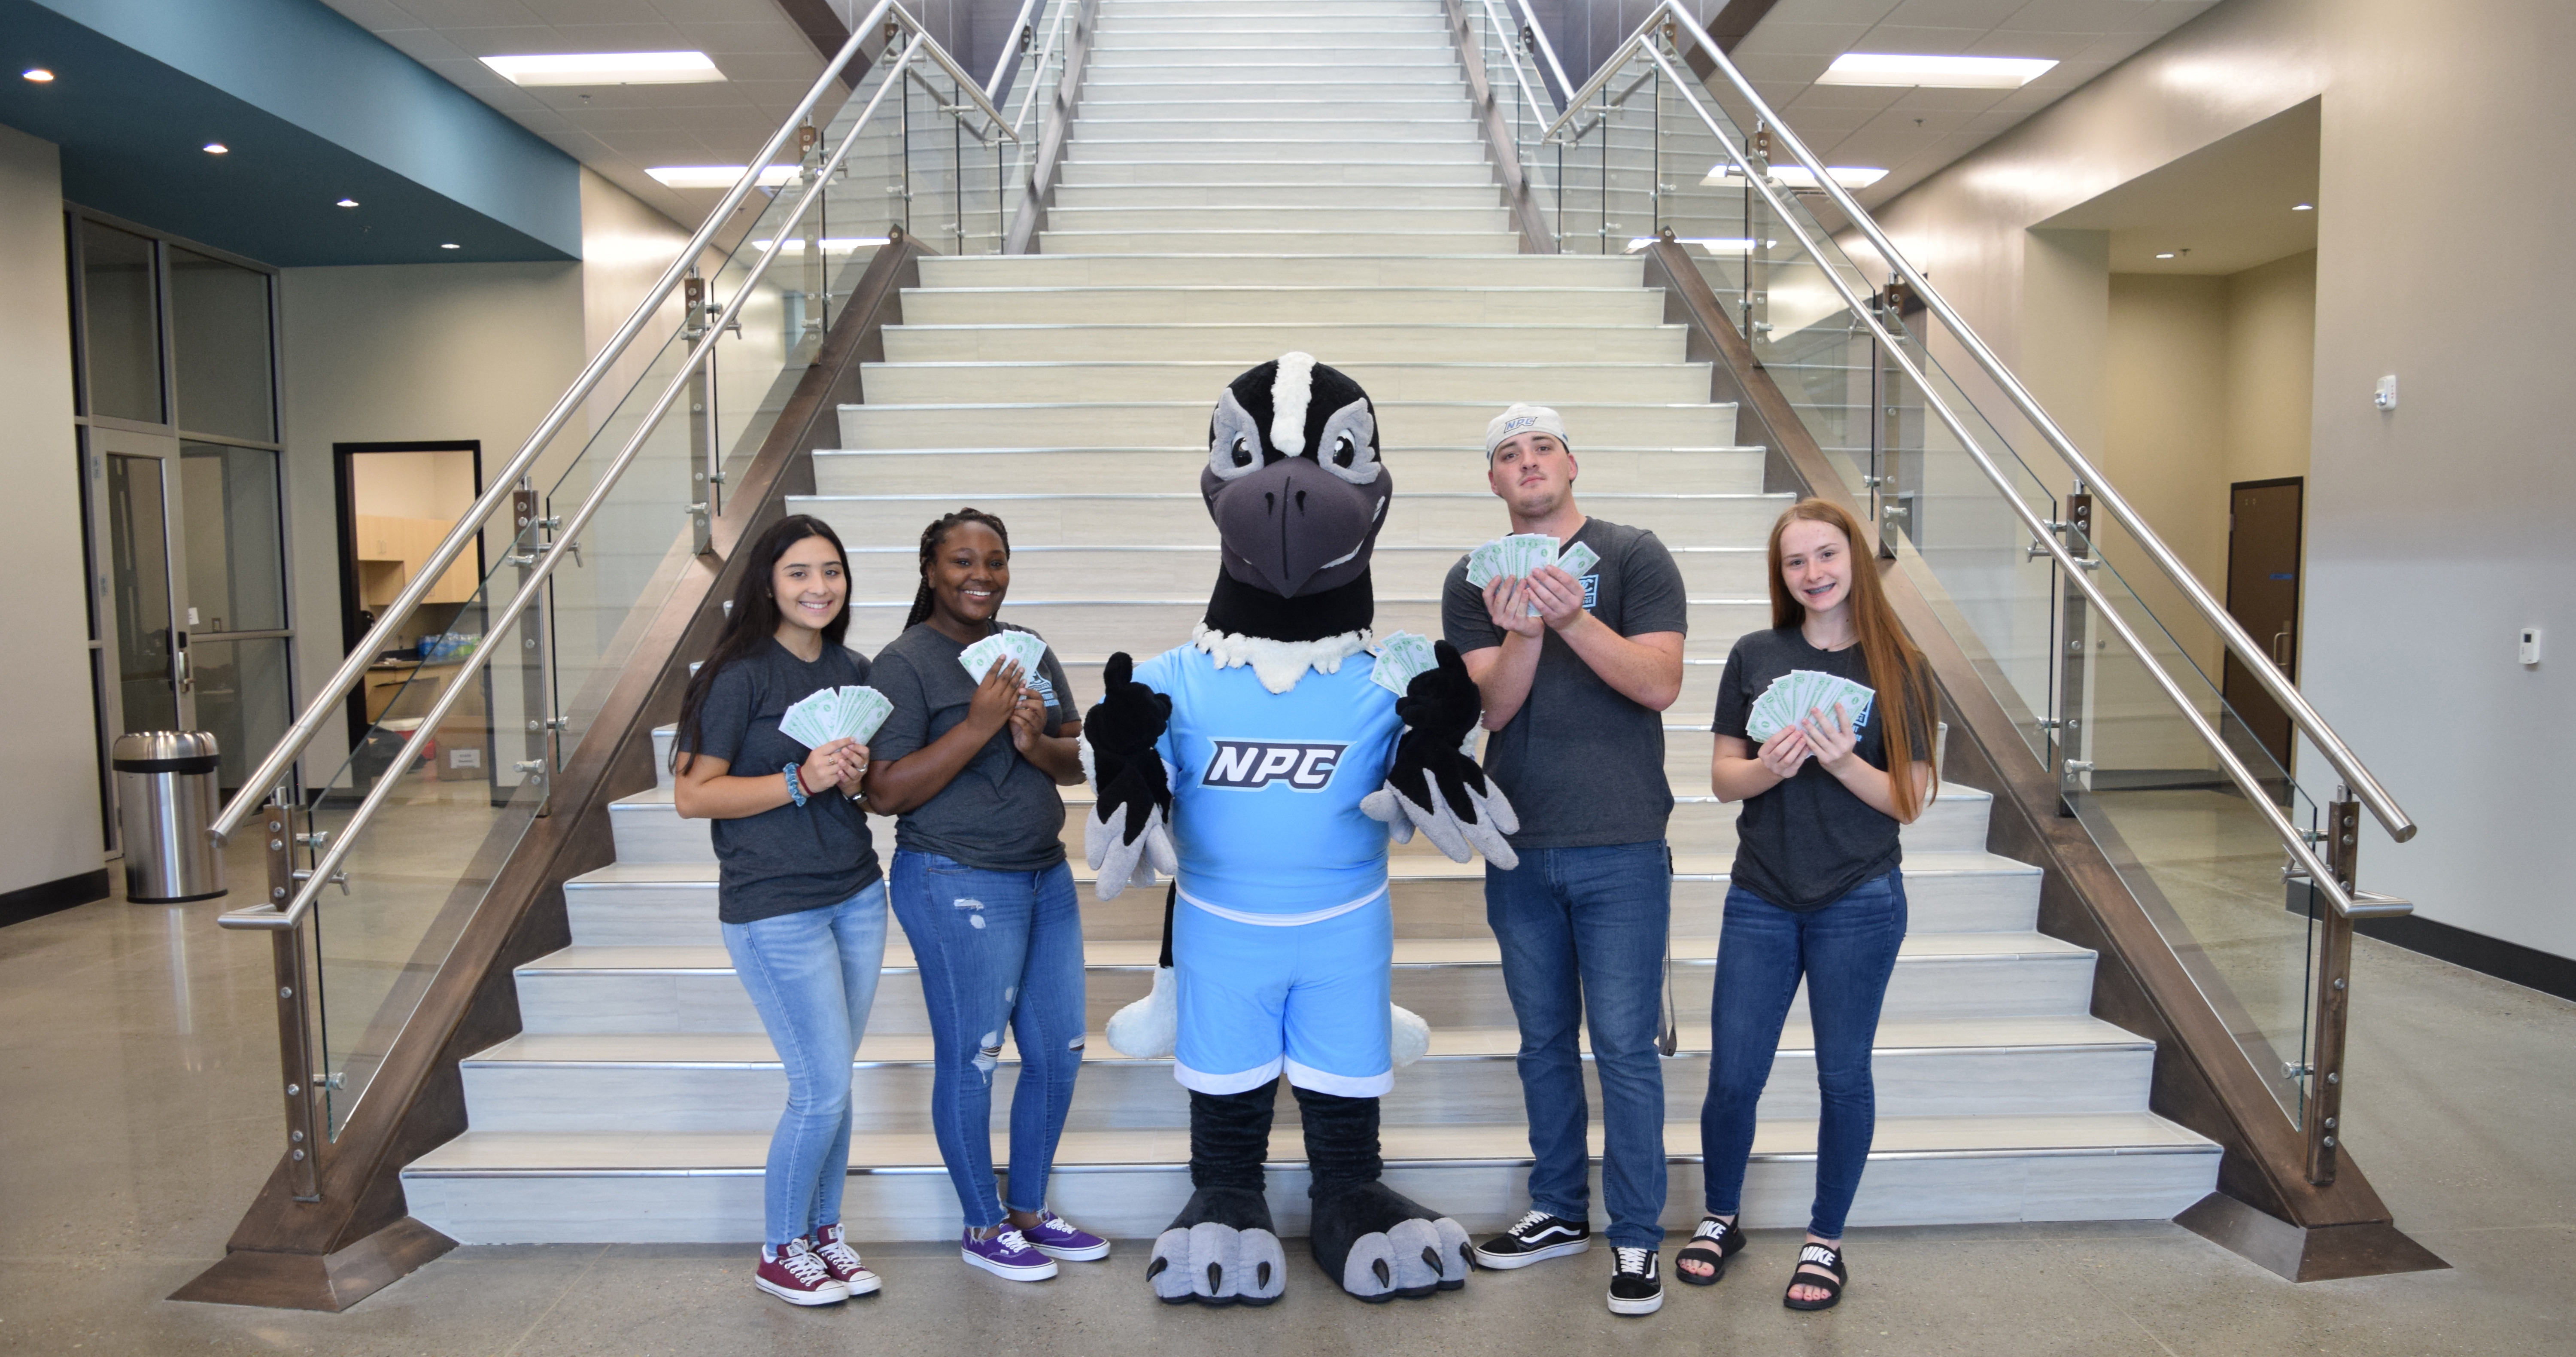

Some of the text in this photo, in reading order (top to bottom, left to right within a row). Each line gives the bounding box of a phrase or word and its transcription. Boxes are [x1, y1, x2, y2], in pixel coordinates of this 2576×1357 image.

[1507, 418, 1534, 430] NPC
[1209, 746, 1336, 784] NPC
[1692, 1220, 1726, 1240] NIKE
[1798, 1246, 1835, 1266] NIKE
